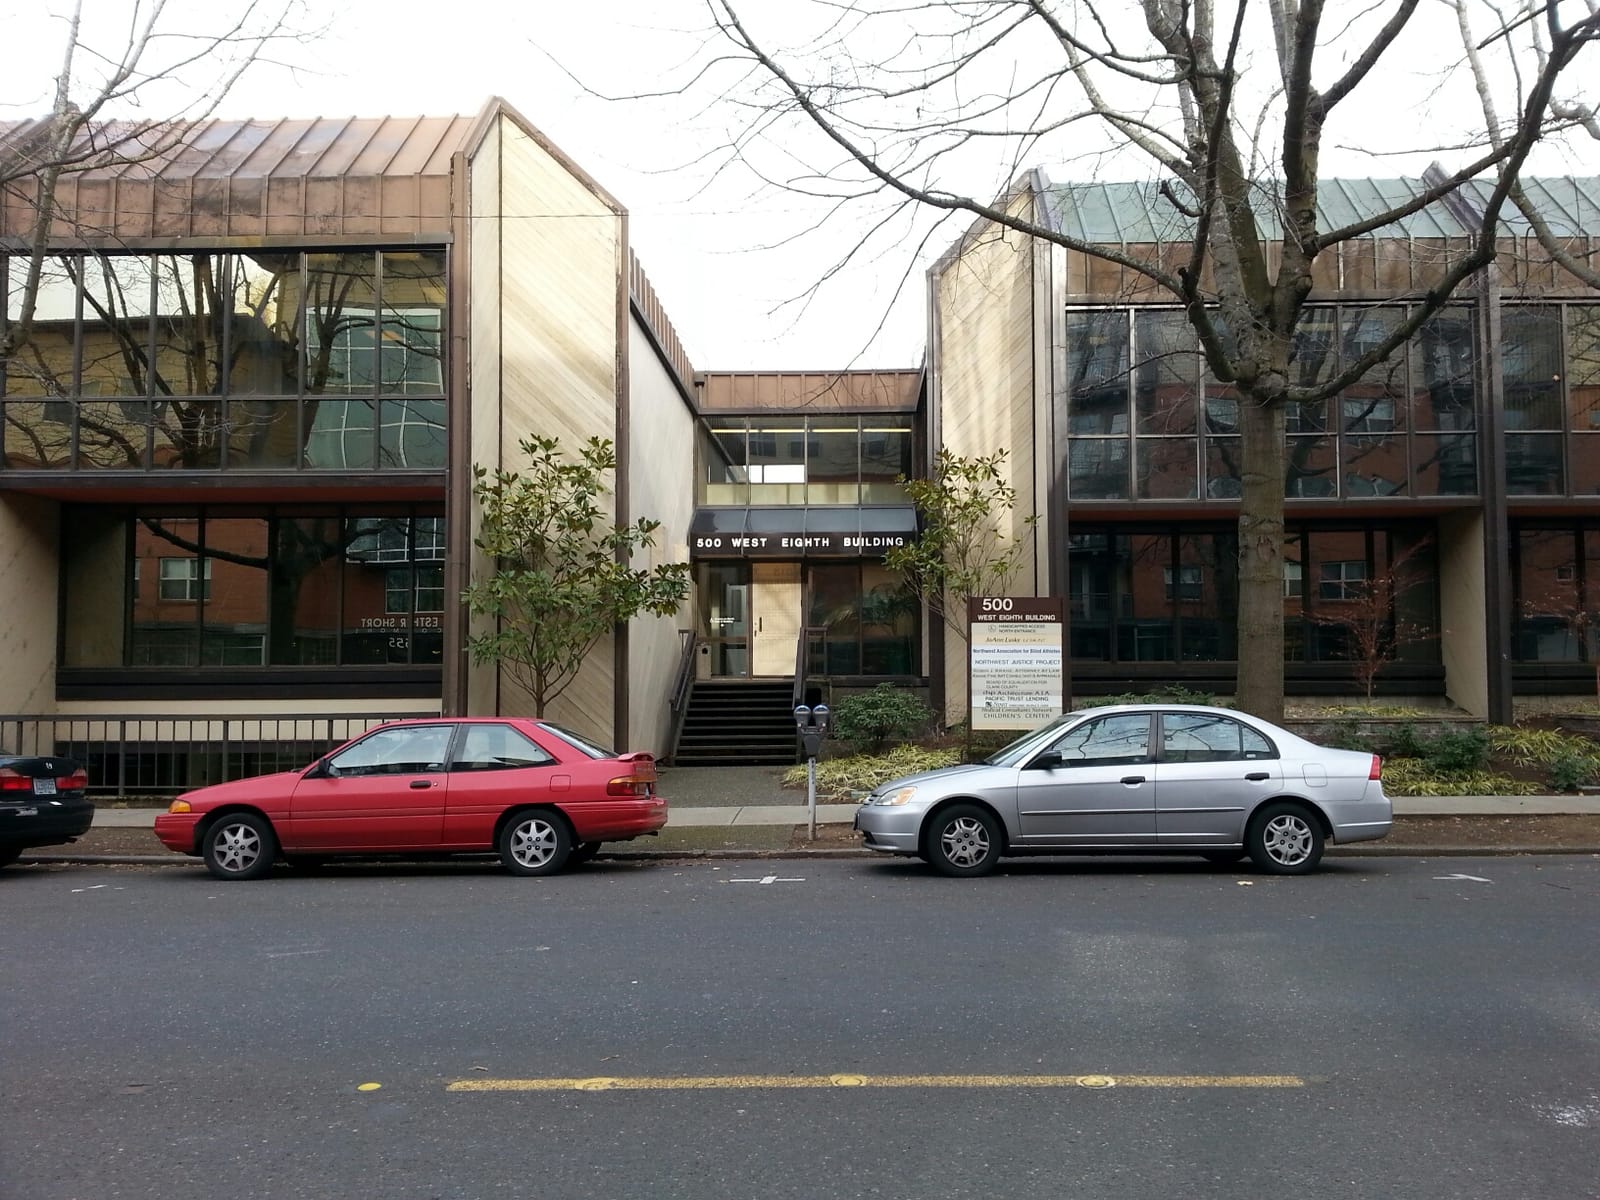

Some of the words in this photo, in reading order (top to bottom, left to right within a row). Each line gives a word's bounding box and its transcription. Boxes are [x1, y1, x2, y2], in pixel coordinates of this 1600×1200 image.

[696, 538, 722, 548] 500
[731, 538, 768, 548] WEST
[781, 537, 830, 547] EIGHTH
[843, 537, 904, 547] BUILDING
[982, 598, 1013, 611] 500
